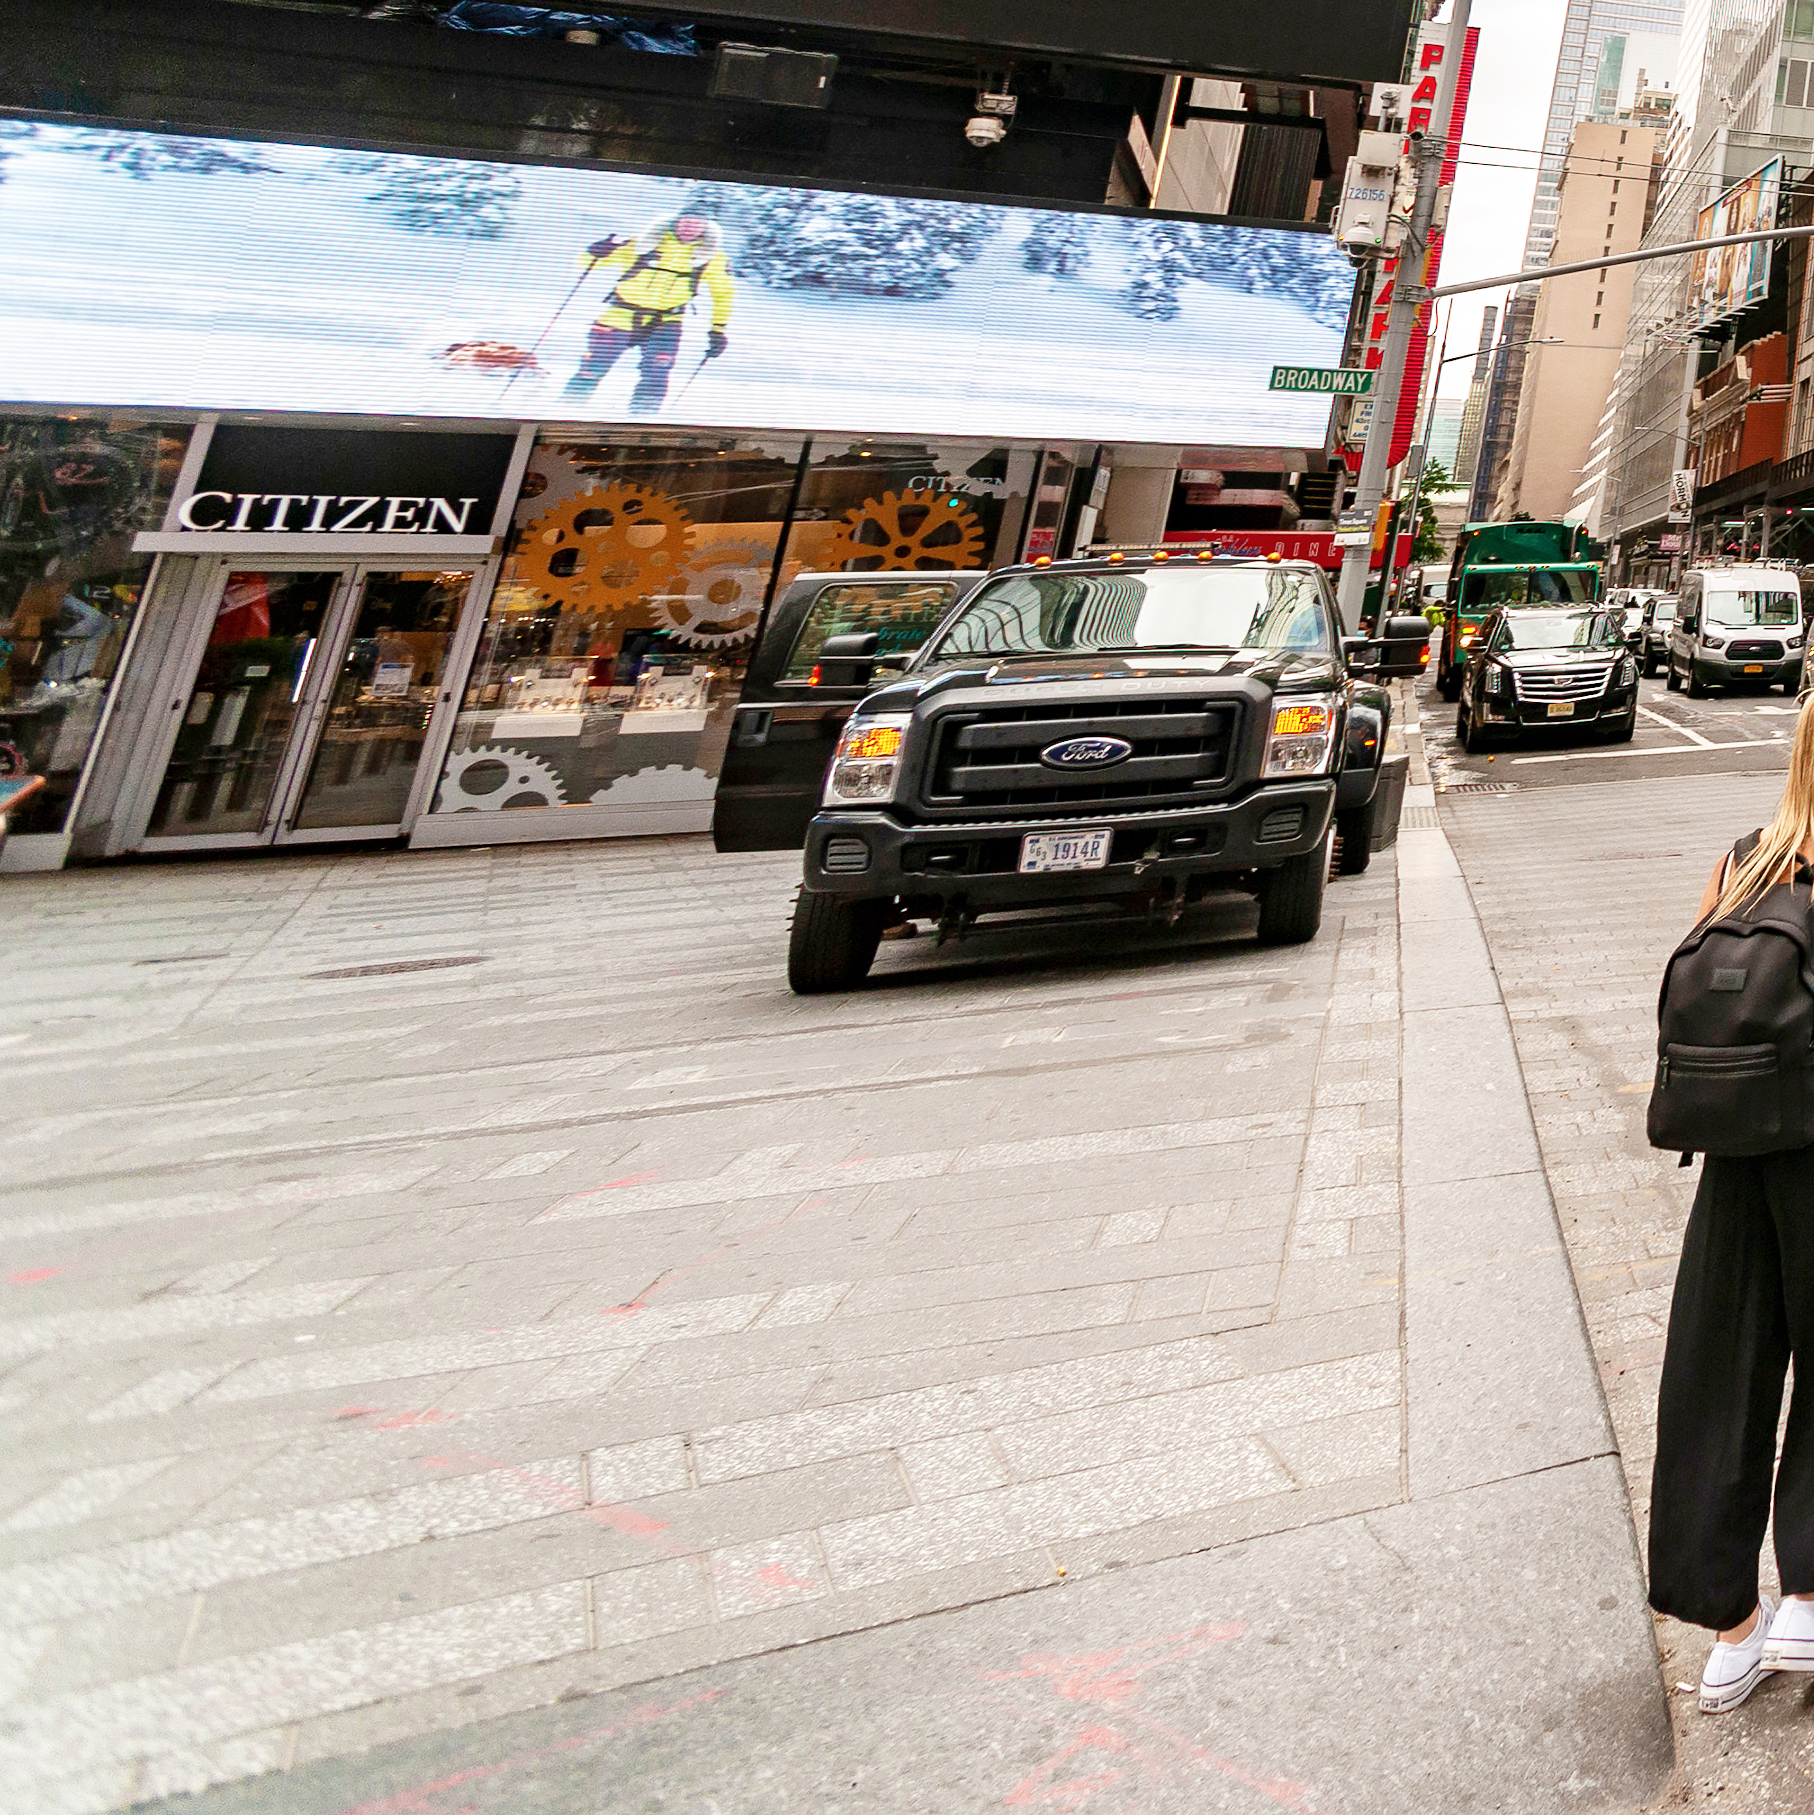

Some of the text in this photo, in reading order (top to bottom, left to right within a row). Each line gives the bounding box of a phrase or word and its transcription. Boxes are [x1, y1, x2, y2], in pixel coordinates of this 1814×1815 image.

[1403, 44, 1445, 155] PAR
[1349, 187, 1386, 201] 726156
[1273, 368, 1369, 392] BROADWAY
[176, 490, 479, 534] CITIZEN
[1274, 541, 1337, 558] DINE
[1061, 742, 1113, 761] Ford
[1052, 840, 1100, 861] 1914R
